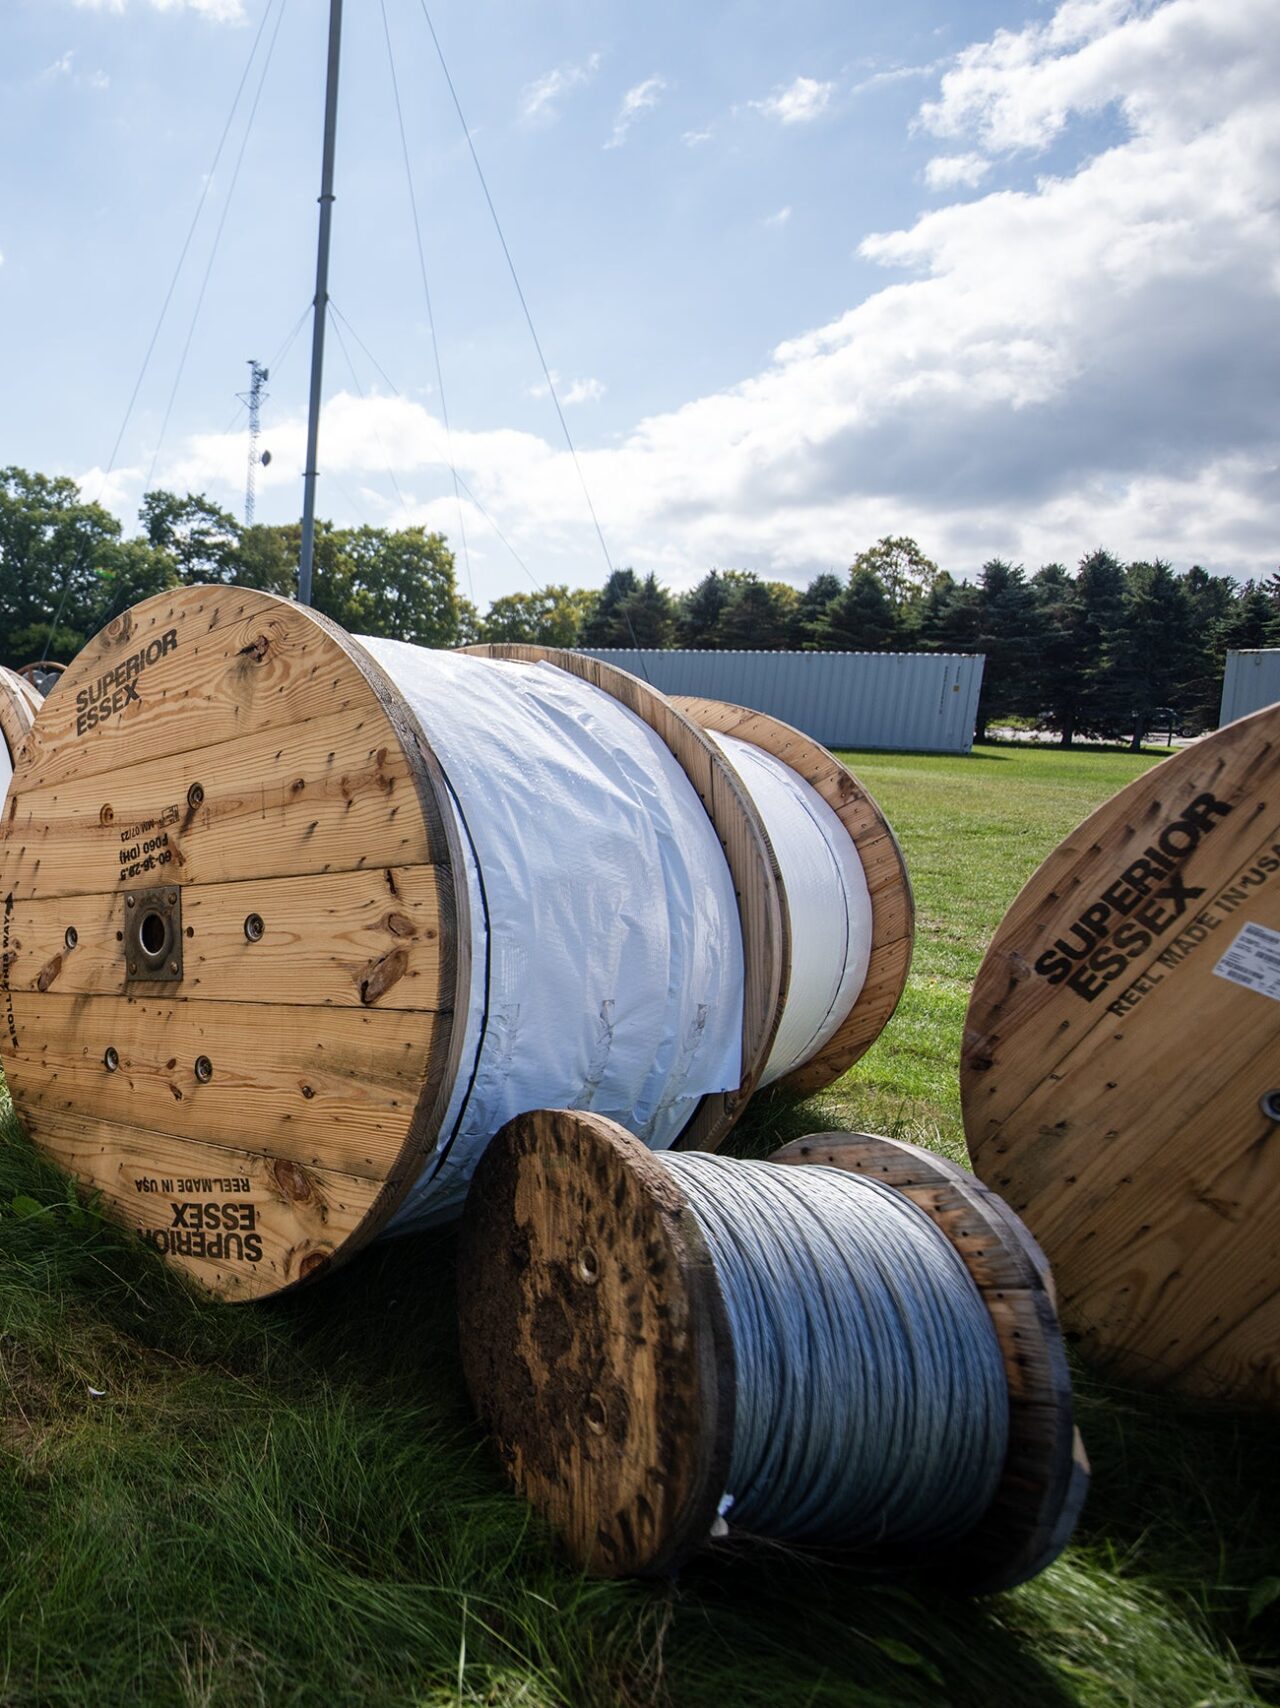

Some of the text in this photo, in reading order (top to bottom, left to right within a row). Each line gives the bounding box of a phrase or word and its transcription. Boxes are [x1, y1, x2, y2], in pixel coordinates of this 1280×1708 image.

[76, 628, 178, 714] SUPERIOR
[76, 677, 140, 737] ESSEX
[119, 832, 169, 865] F060 (DH)
[120, 825, 140, 843] 07/23
[1034, 792, 1234, 985] SUPERIOR
[2, 915, 12, 948] WAY
[1066, 871, 1207, 1004] ESSEX
[1109, 970, 1165, 1018] REEL
[1159, 911, 1223, 970] MADE
[1214, 885, 1250, 913] IN
[6, 993, 17, 1036] ROLL
[134, 1178, 251, 1193] REEL MADE IN USA
[170, 1202, 256, 1231] ESSEX
